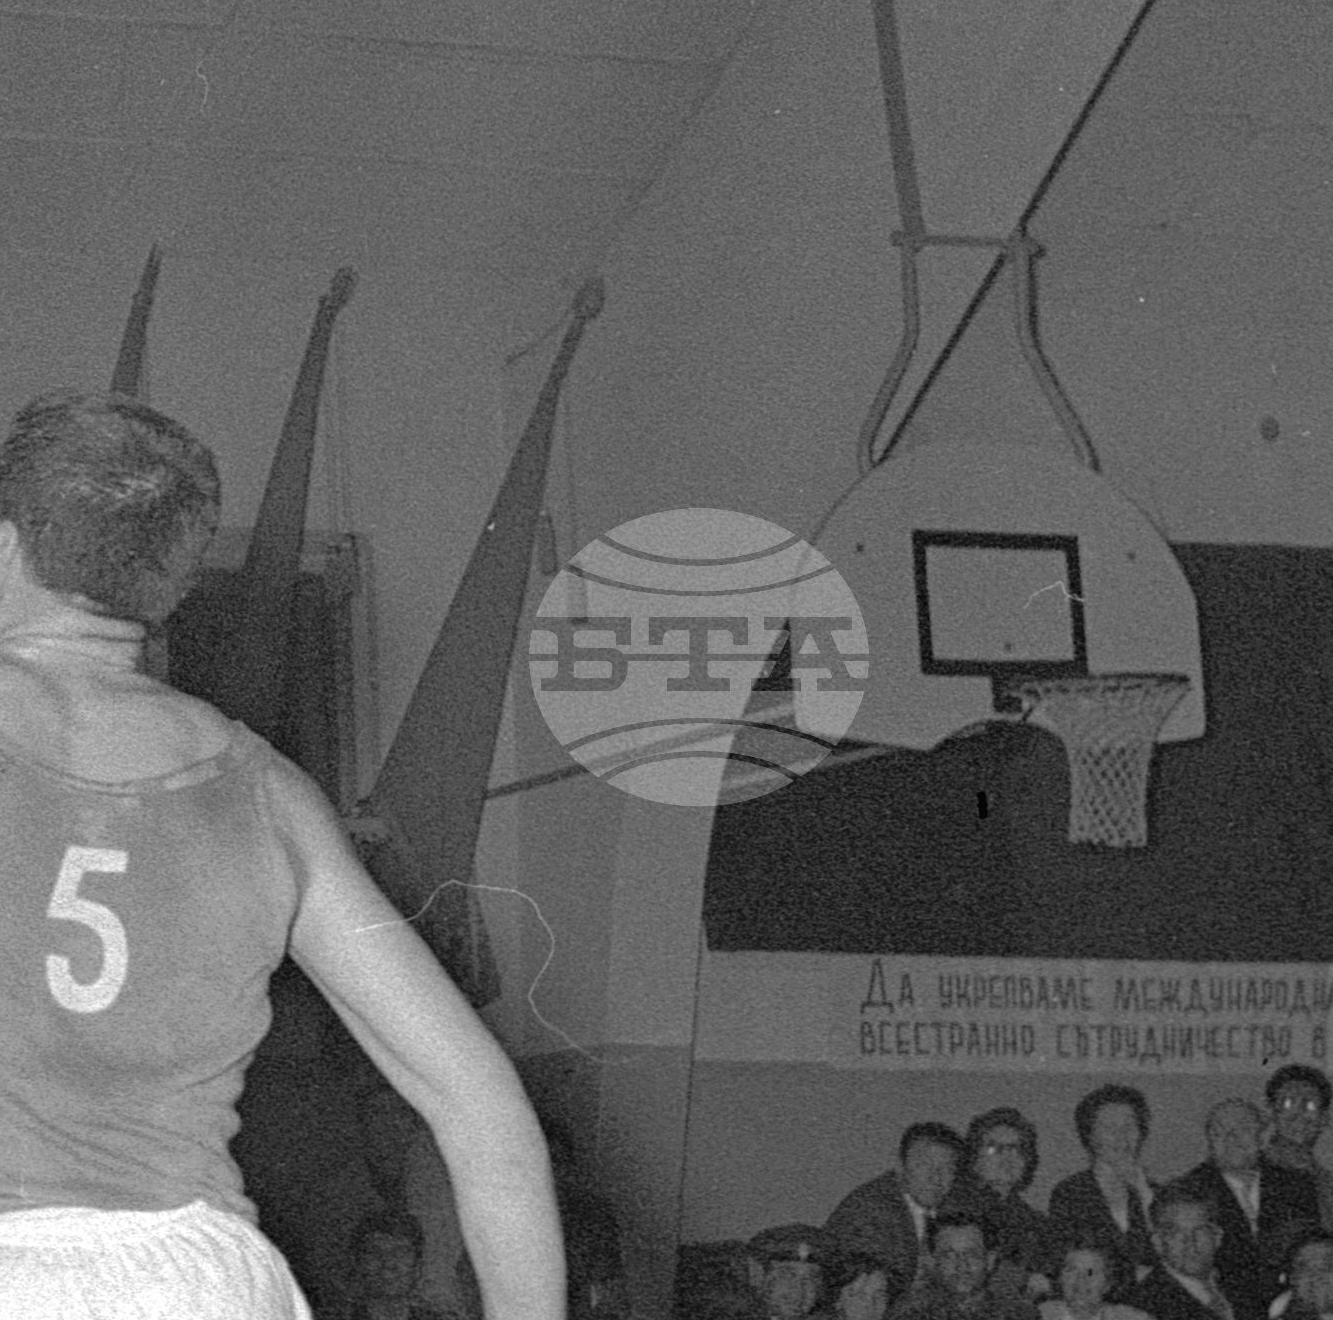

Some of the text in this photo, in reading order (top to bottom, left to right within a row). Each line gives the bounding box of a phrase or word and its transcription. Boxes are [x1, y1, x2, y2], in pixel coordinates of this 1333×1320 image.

[45, 845, 129, 1014] 5
[938, 972, 1093, 1010] УКРЕПВАМЕ
[859, 1021, 1035, 1057] ВСЕСТРАННО
[1055, 1023, 1292, 1066] СЪТРУДНИЧЕСТВО
